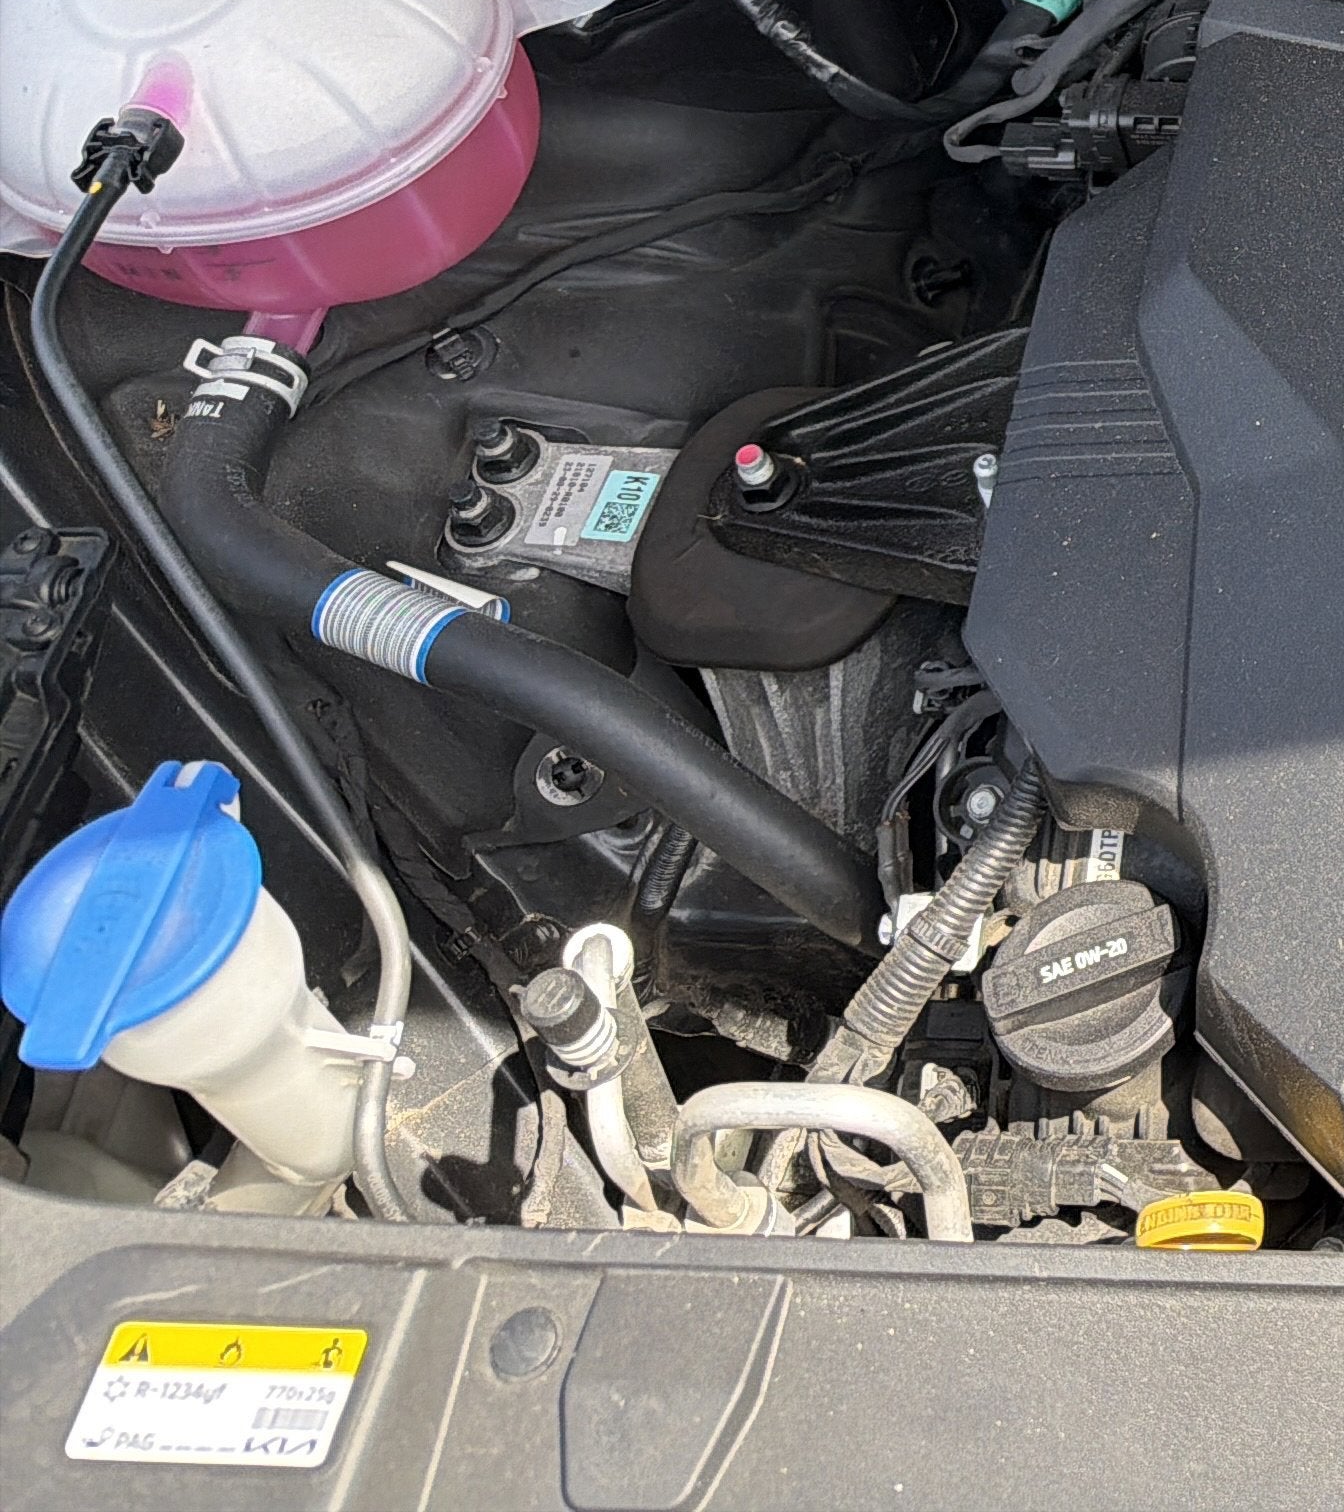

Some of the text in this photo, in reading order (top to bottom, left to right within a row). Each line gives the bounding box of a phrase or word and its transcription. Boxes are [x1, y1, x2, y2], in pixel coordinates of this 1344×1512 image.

[617, 475, 651, 501] K10
[1040, 938, 1128, 984] SAE 0W-20
